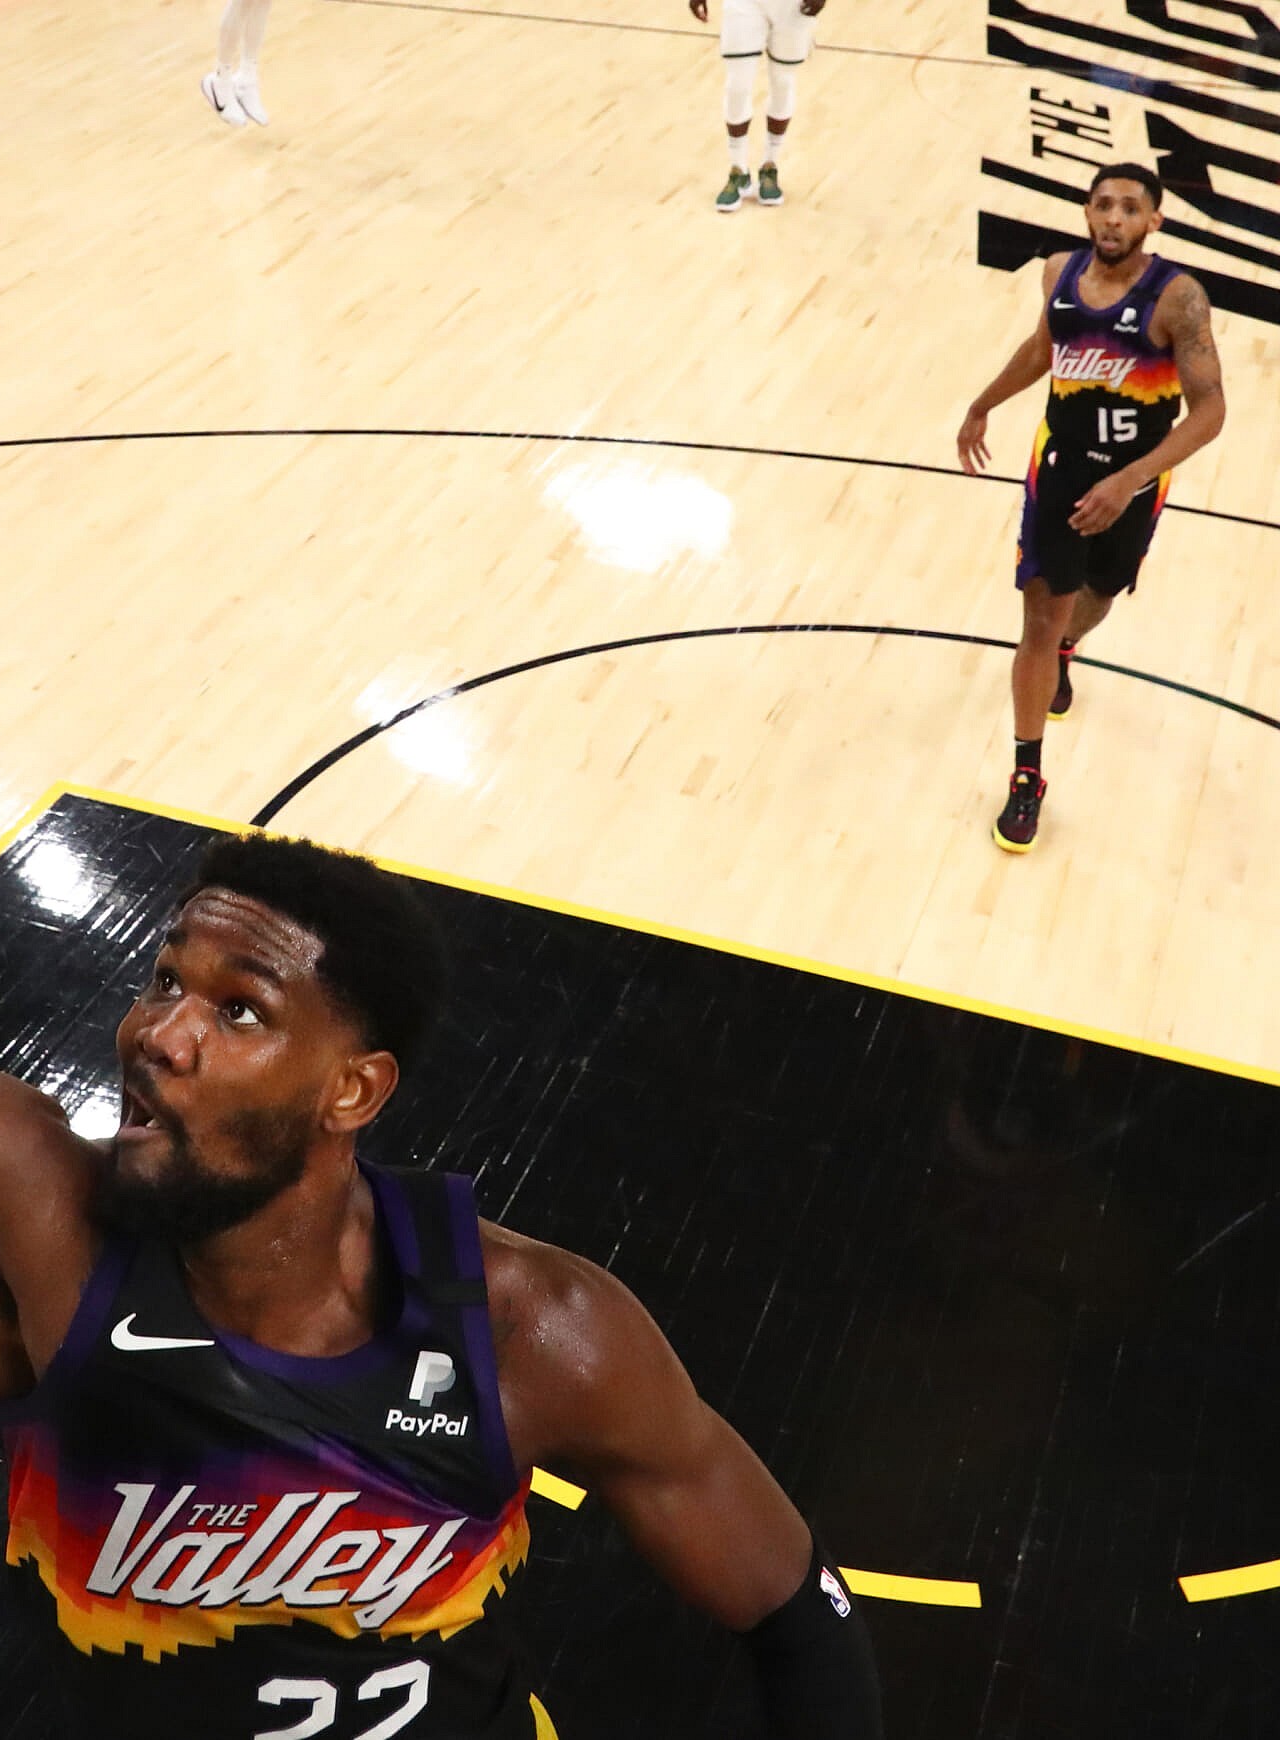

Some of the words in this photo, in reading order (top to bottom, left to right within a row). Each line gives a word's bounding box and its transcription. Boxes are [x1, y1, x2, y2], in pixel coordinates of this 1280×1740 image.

[1030, 87, 1112, 166] THE
[1052, 343, 1137, 388] Valley
[1098, 407, 1138, 443] 15
[385, 1409, 468, 1437] PayPal
[189, 1503, 258, 1528] THE
[86, 1482, 469, 1631] Valley
